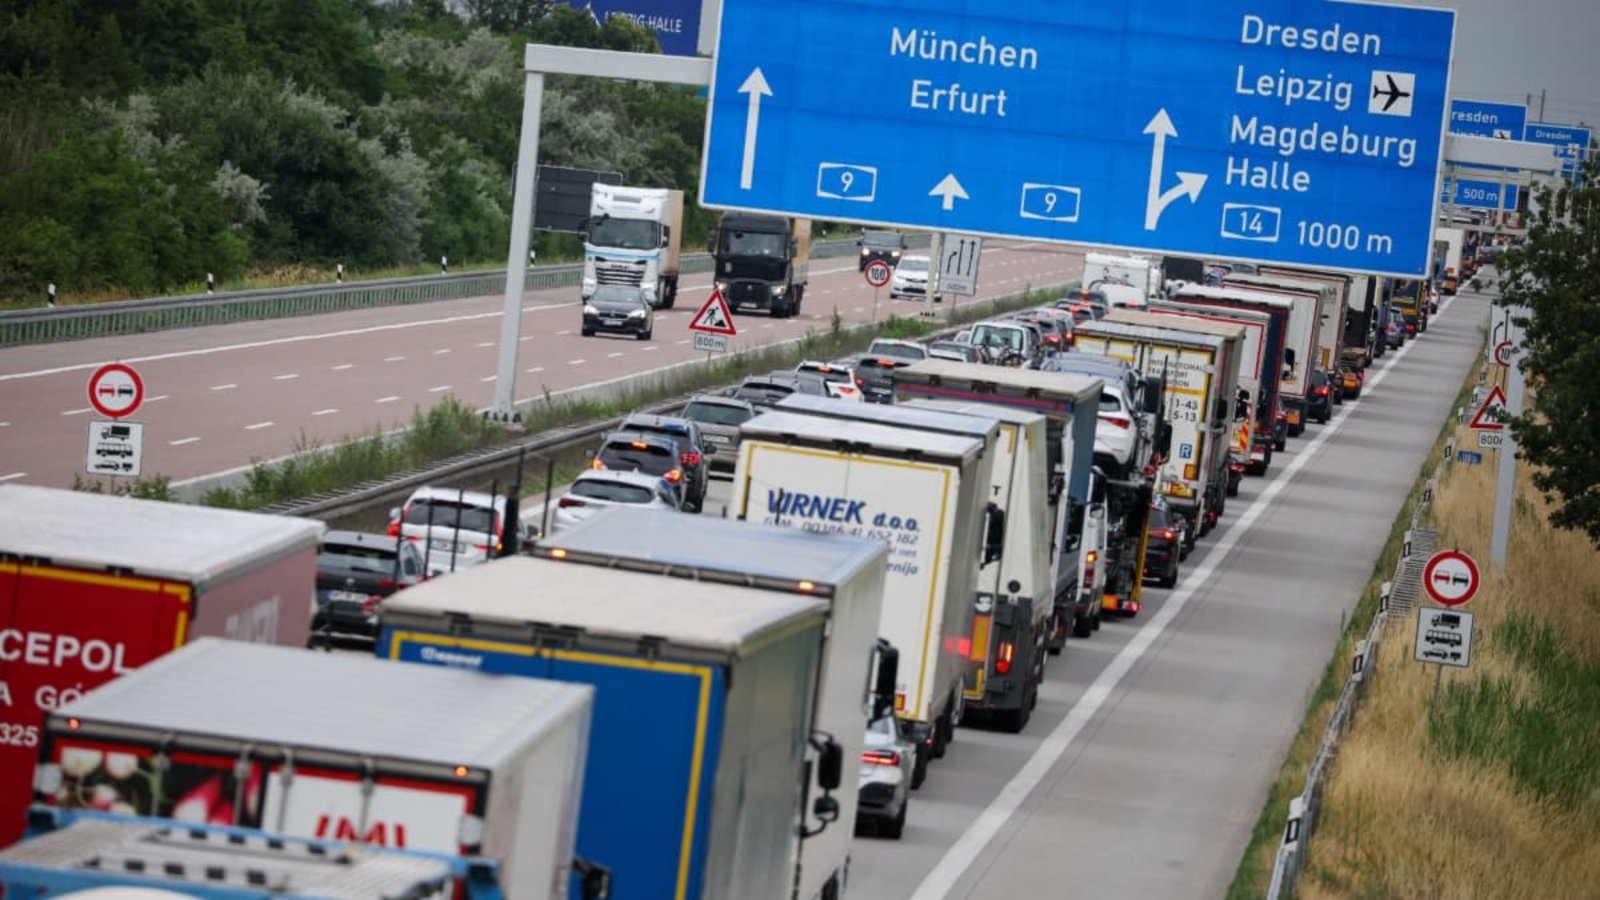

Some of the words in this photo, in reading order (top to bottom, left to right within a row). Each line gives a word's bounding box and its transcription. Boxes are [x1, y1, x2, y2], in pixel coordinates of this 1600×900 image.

[1241, 14, 1381, 56] Dresden
[889, 26, 1039, 70] München
[910, 79, 1008, 117] Erfurt
[1235, 65, 1353, 111] Leipzig
[1451, 110, 1499, 124] resden
[1229, 114, 1418, 167] Magdeburg
[1535, 129, 1573, 141] Dresden
[840, 171, 855, 192] 9
[1225, 156, 1311, 193] Halle
[1043, 192, 1058, 213] 9
[1463, 187, 1486, 200] 500
[1486, 192, 1498, 201] m
[1238, 210, 1263, 234] 14
[1297, 220, 1360, 251] 1000
[1366, 231, 1393, 255] m
[871, 267, 886, 281] 100
[1501, 347, 1511, 360] 10
[768, 489, 867, 525] VIRNEK
[873, 512, 920, 532] d.o.o.
[896, 532, 919, 545] 182
[885, 561, 919, 577] enija
[0, 628, 138, 675] CEPOL
[0, 722, 39, 747] 325
